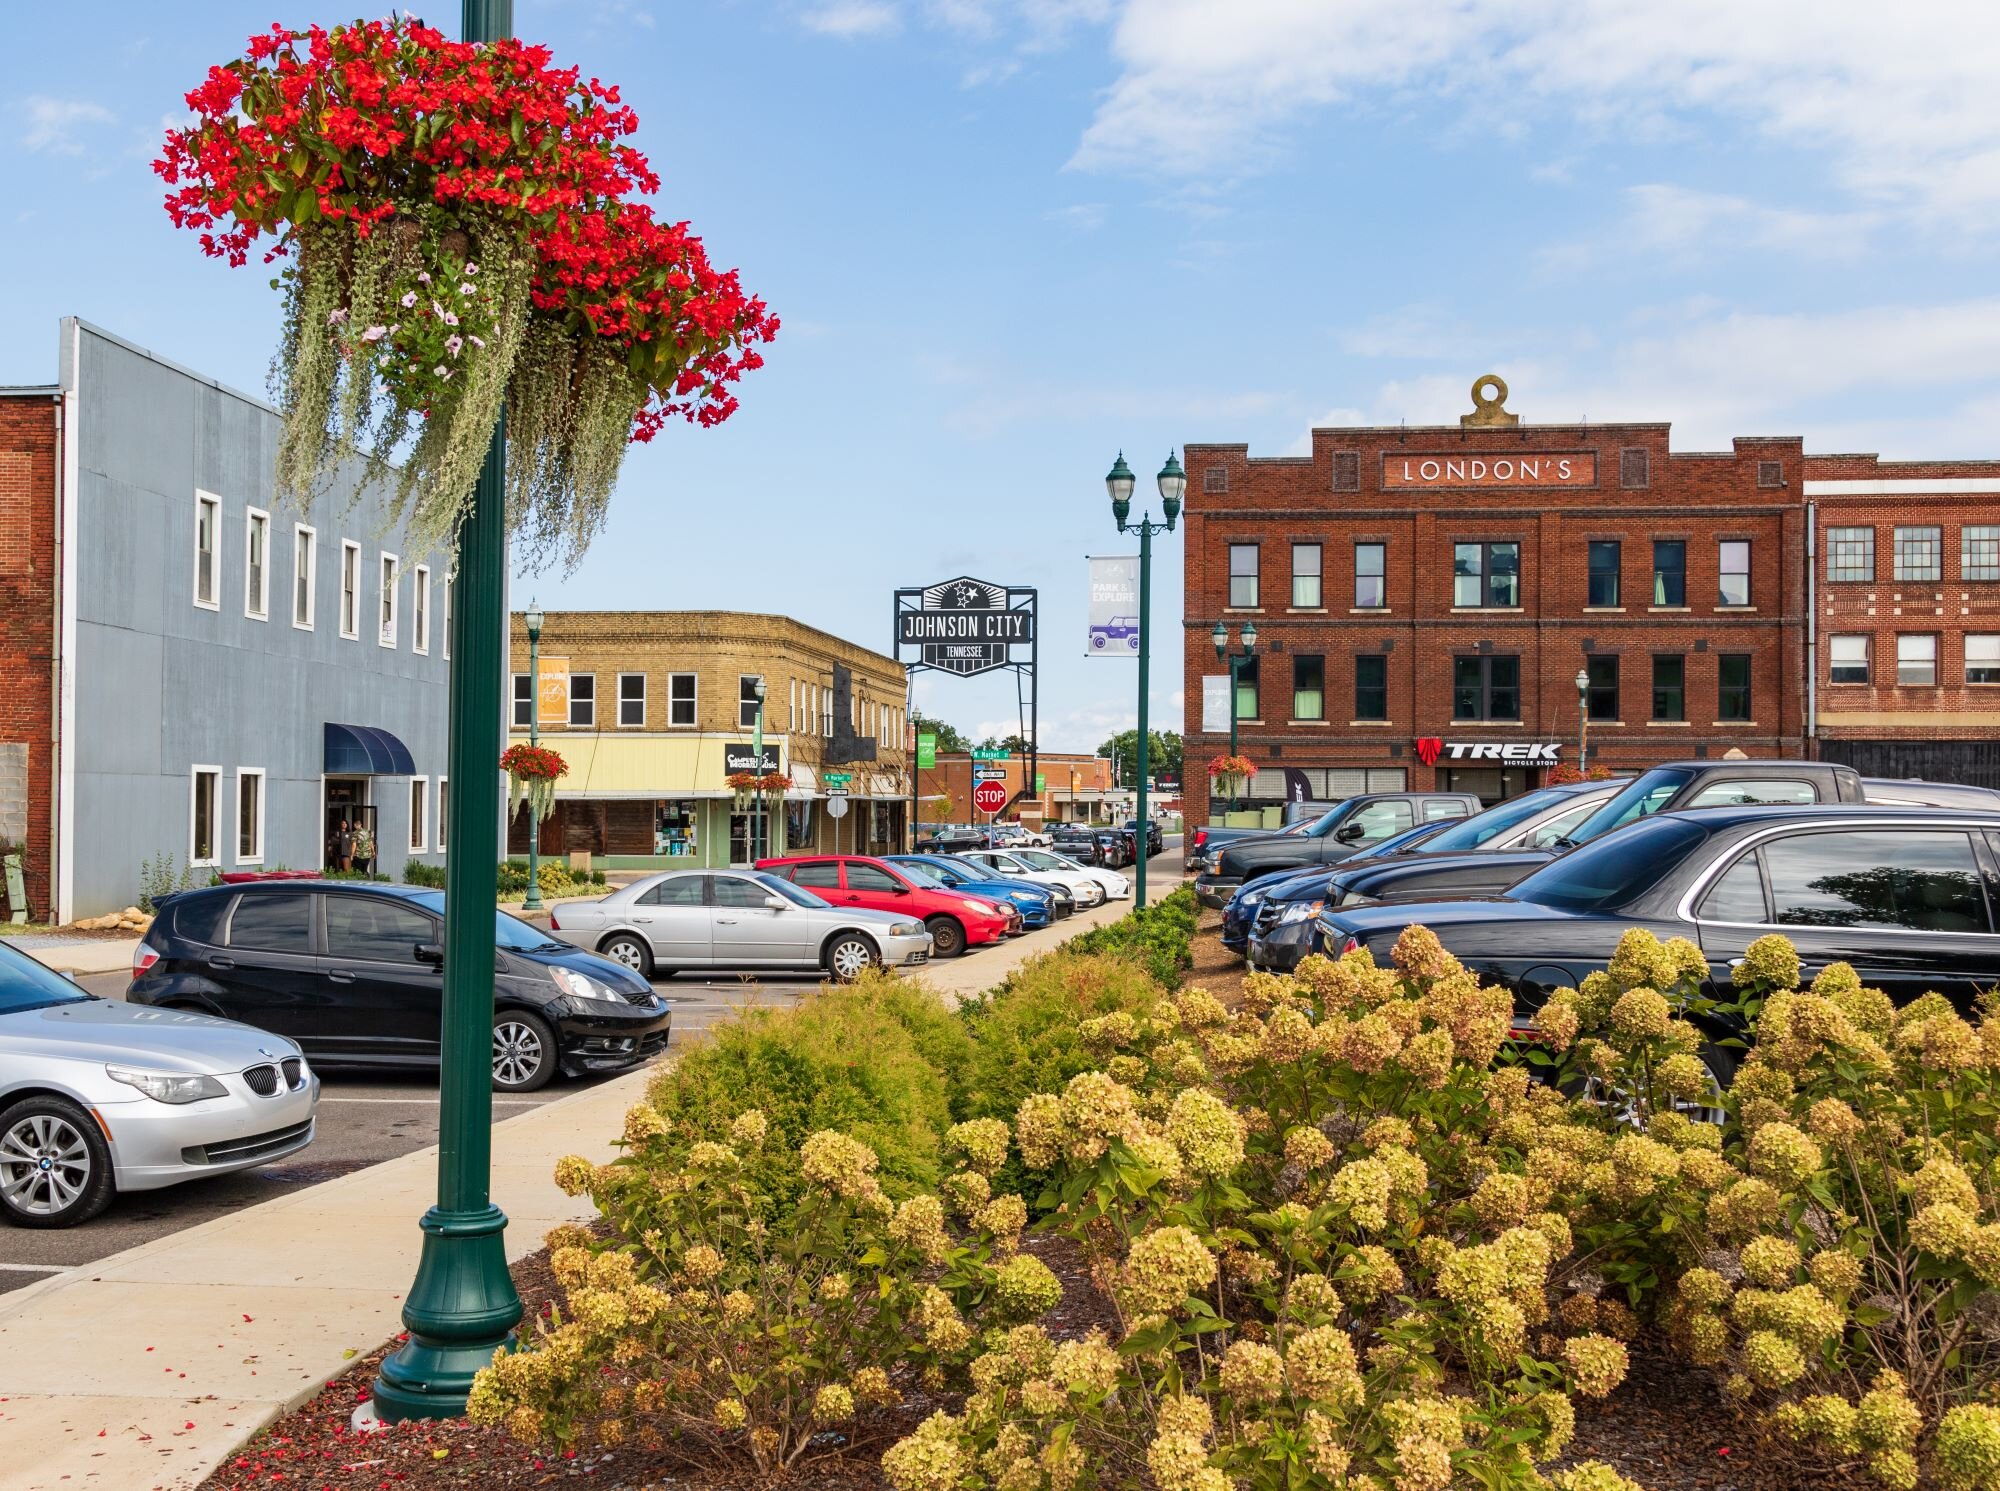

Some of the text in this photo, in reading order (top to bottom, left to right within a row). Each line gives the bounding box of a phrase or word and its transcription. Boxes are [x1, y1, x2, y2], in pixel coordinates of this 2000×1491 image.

[1404, 460, 1571, 481] LONDON'S
[1093, 583, 1119, 592] PARK
[1093, 592, 1135, 602] EXPLORE
[905, 615, 1023, 637] JOHNSON CITY
[946, 645, 983, 658] TENNESSEE
[981, 751, 1000, 759] Market
[1445, 743, 1563, 759] TREK
[976, 790, 1005, 803] STOP
